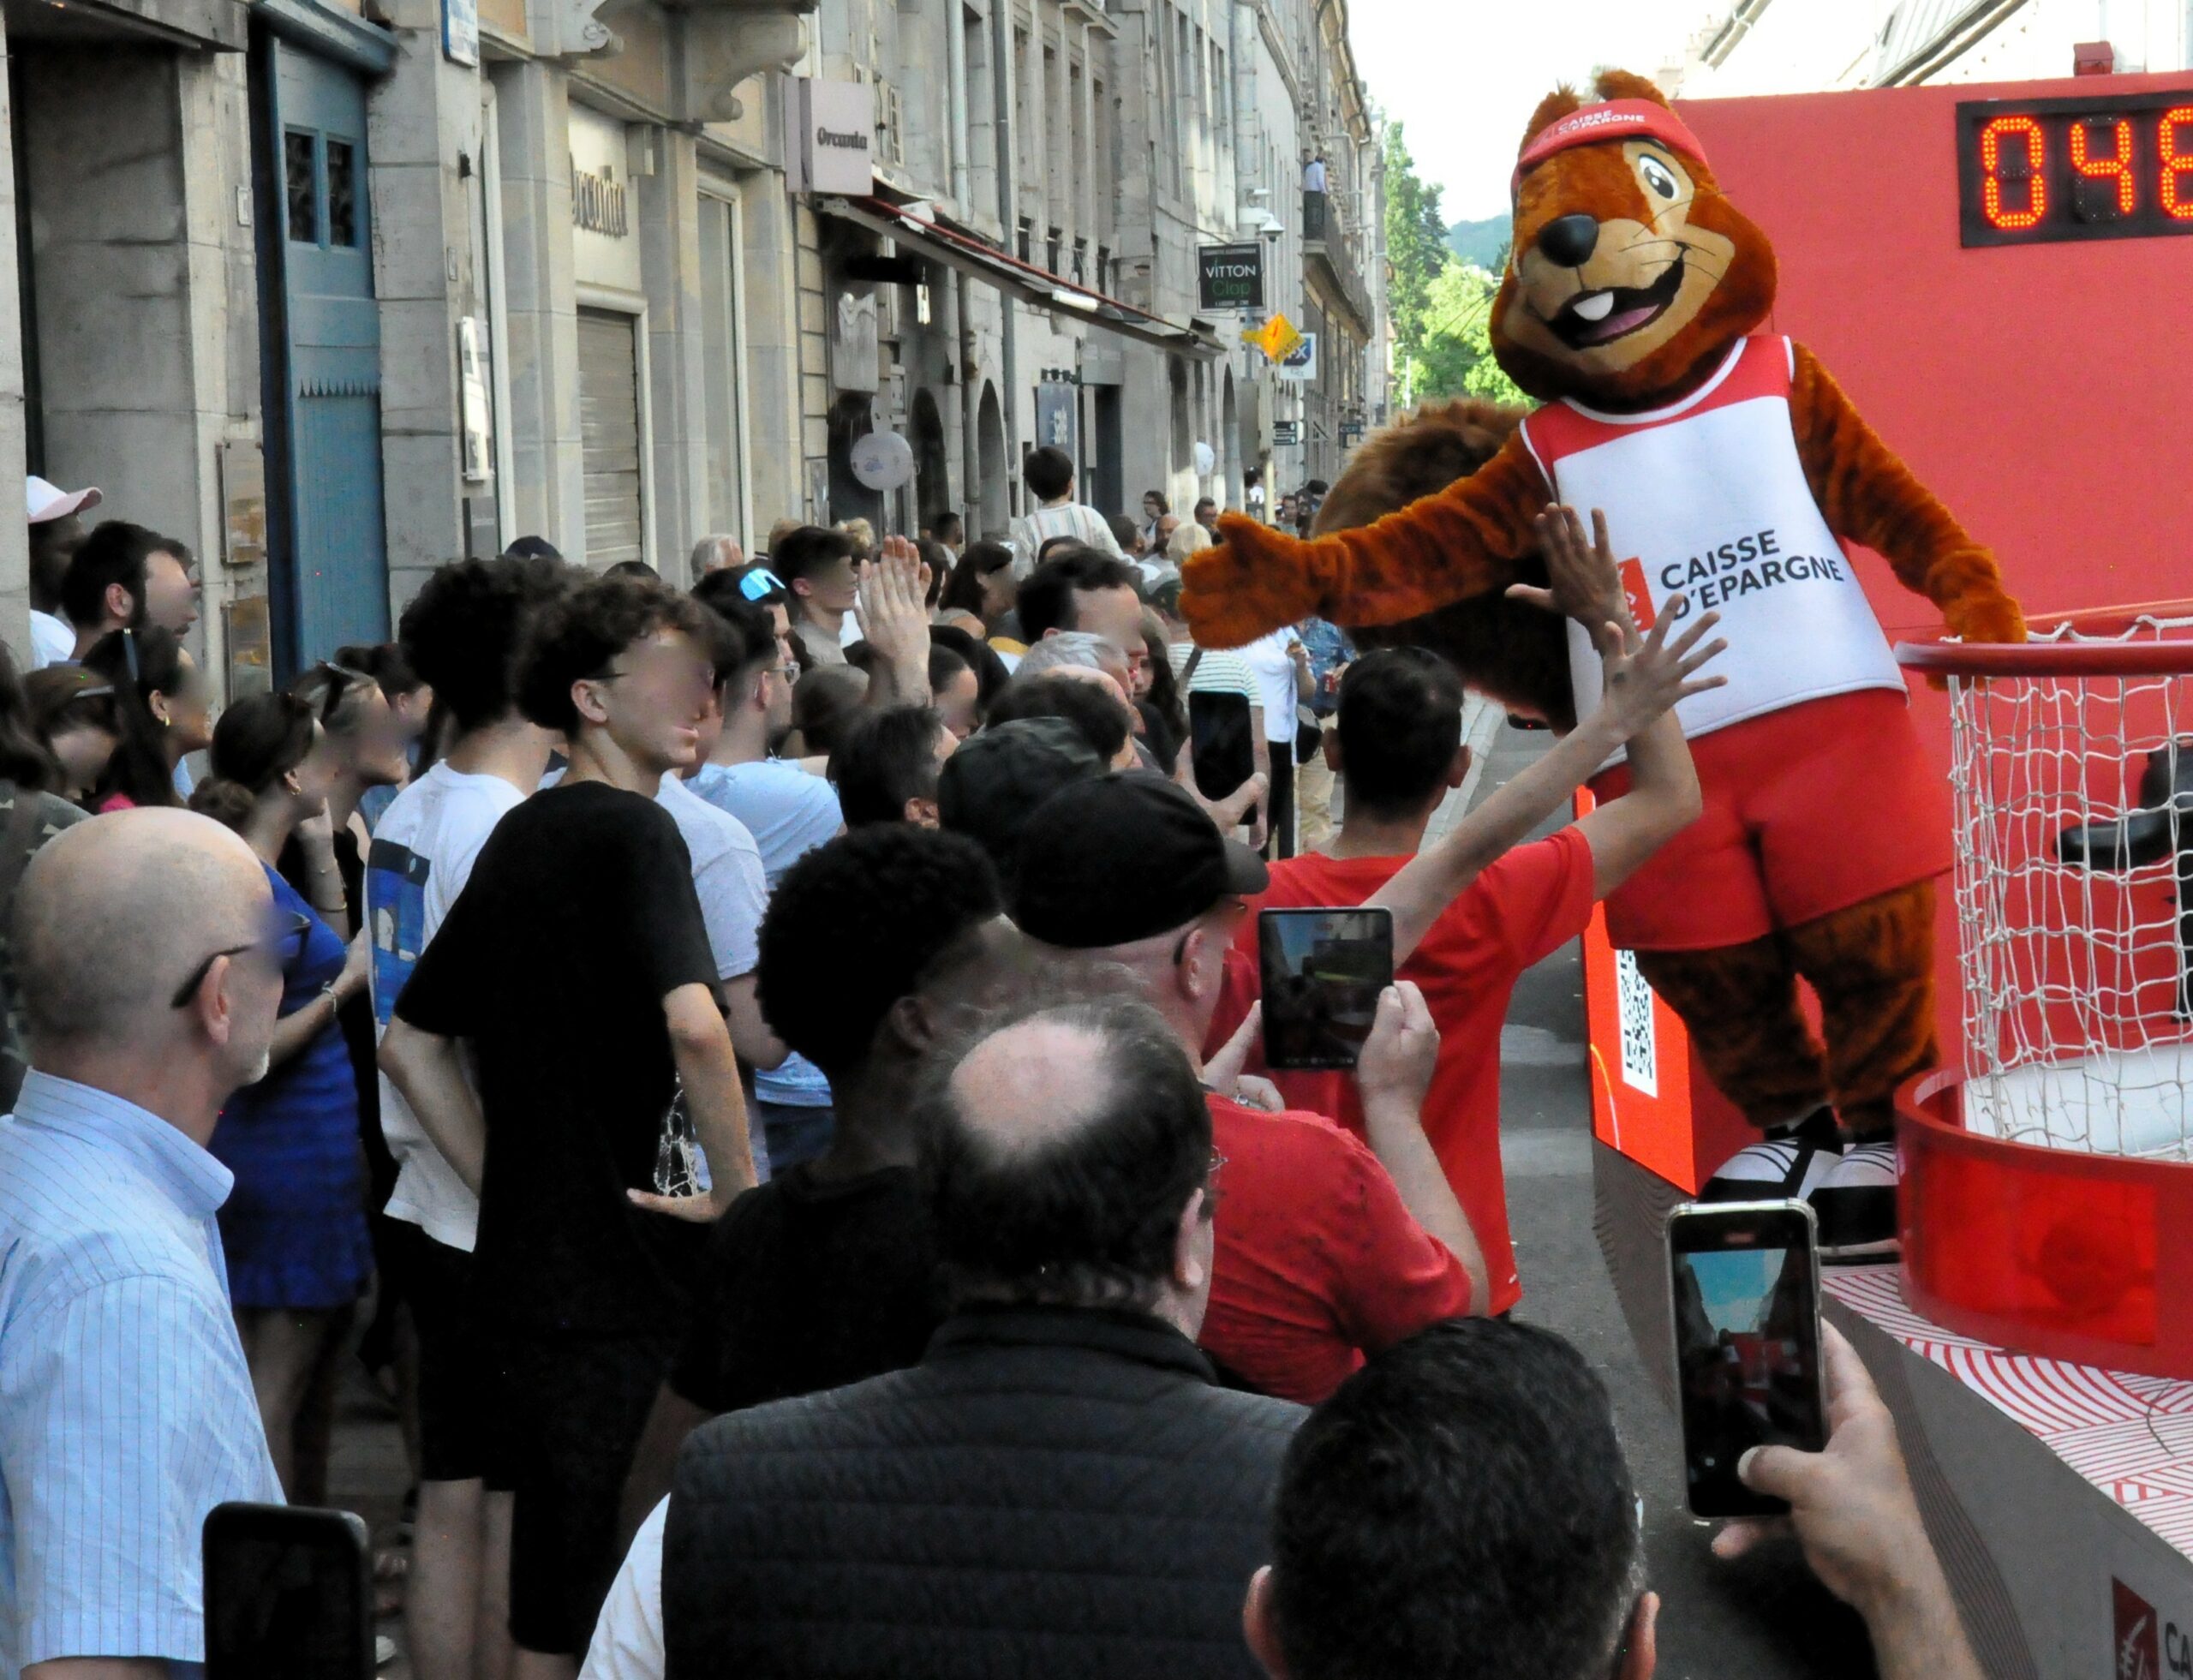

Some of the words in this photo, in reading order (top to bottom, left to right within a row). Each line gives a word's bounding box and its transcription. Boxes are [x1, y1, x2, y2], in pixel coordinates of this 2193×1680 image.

[1558, 110, 1612, 131] CAISSE
[817, 127, 867, 150] Orcanta
[570, 152, 628, 238] rcanta
[1205, 264, 1256, 278] VITTON
[1660, 529, 1780, 589] CAISSE
